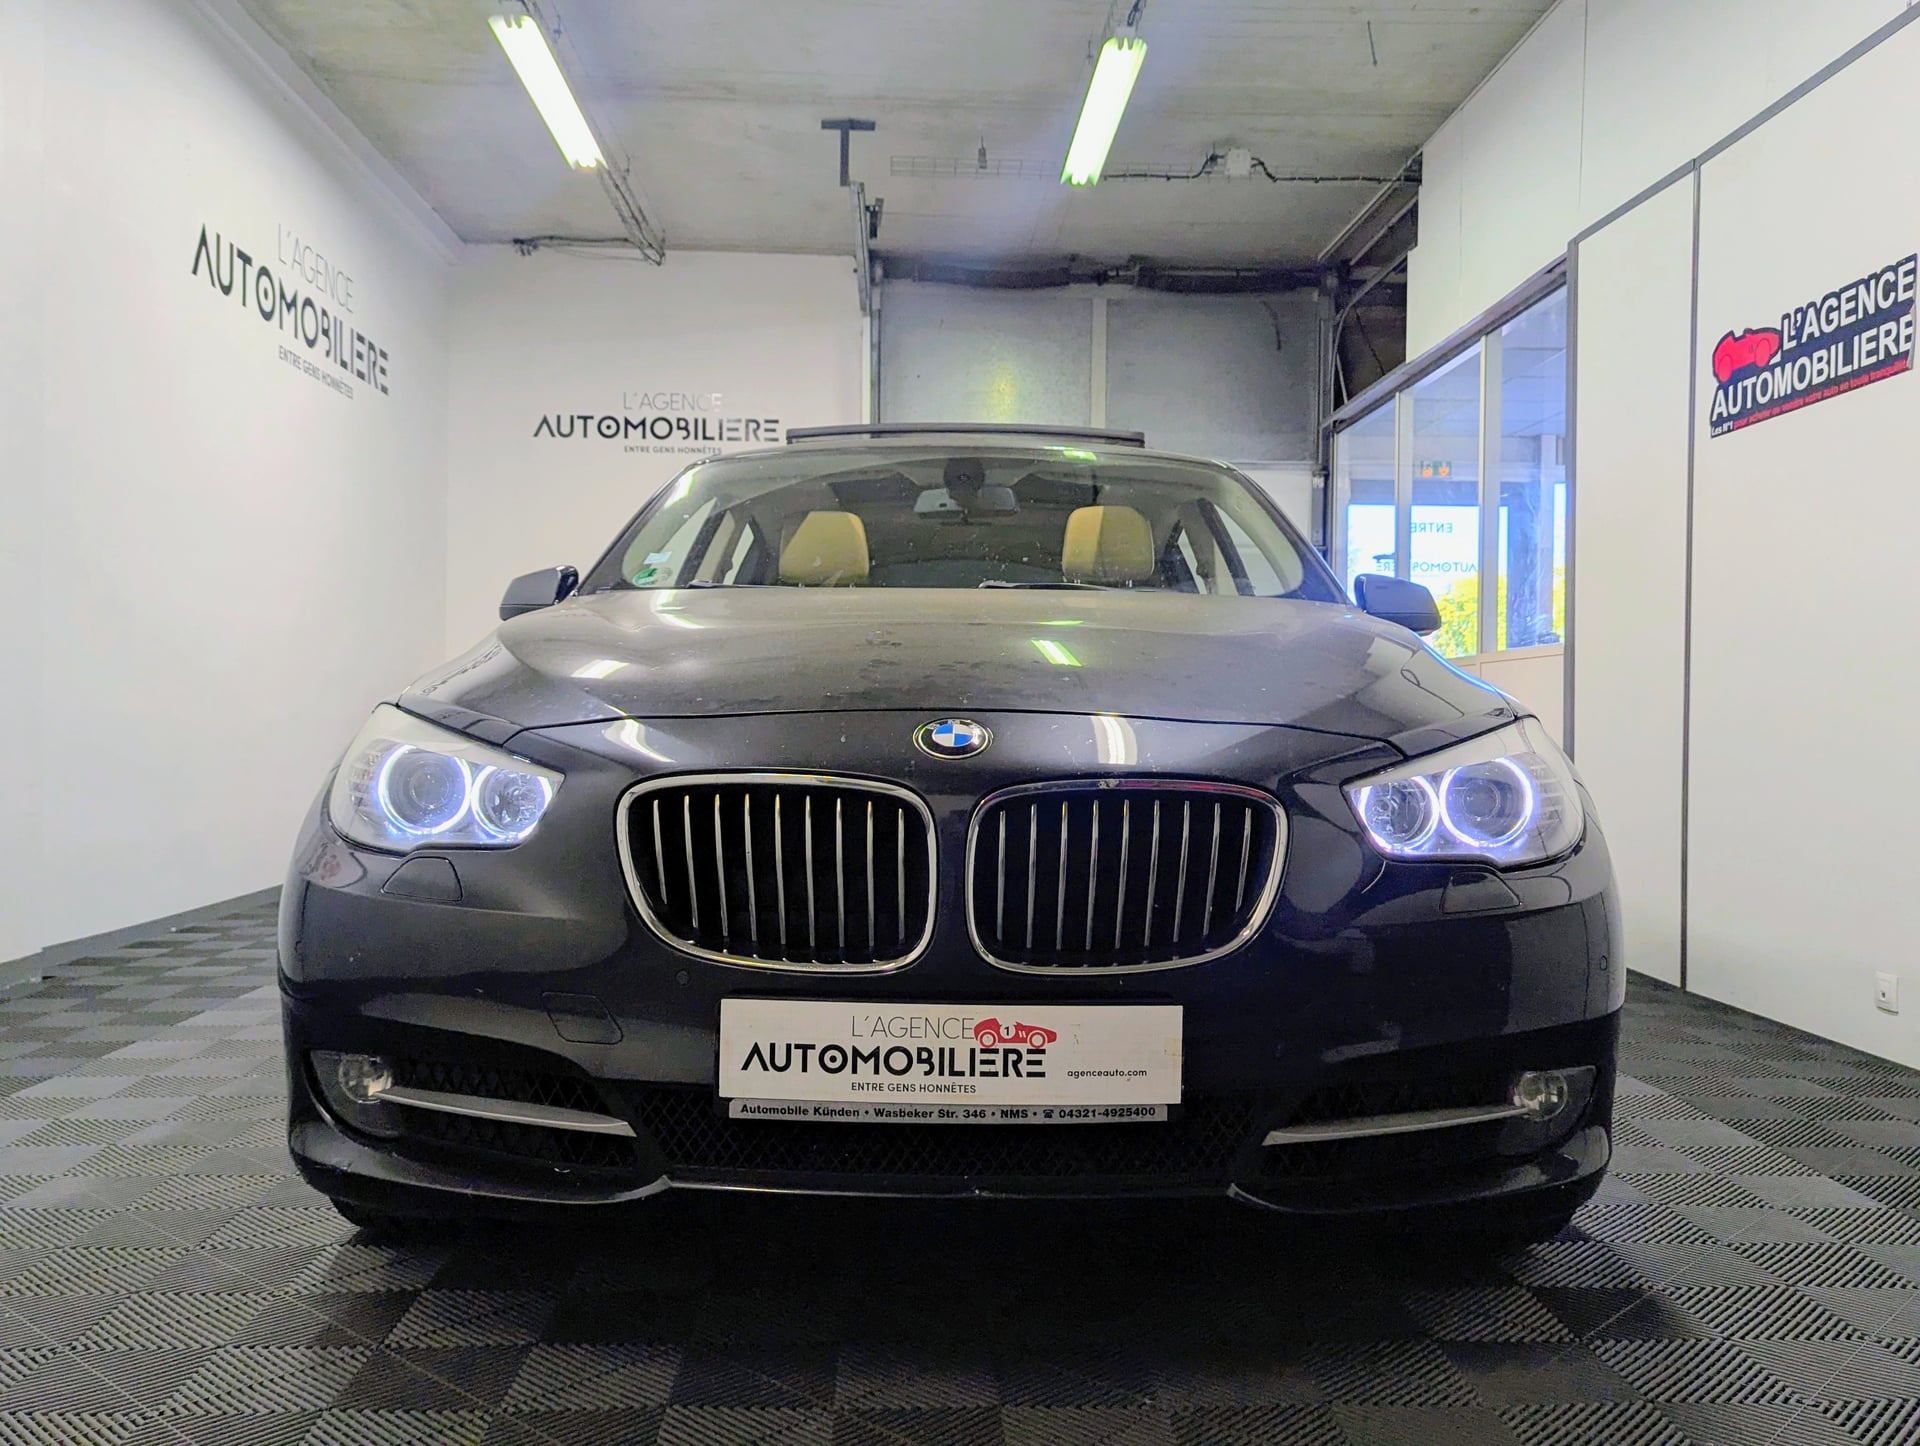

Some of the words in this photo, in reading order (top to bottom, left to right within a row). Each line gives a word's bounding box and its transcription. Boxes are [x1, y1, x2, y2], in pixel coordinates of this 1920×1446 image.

[278, 223, 354, 314] L'AGENCE
[191, 222, 389, 396] AUTOMOBILIERE
[1782, 260, 1915, 351] L'AGENCE
[1711, 315, 1913, 421] AUTOMOBILIERE
[623, 392, 723, 412] L'AGENCE
[533, 414, 780, 443] AUTOMOBILIERE
[624, 445, 651, 454] ENTRE
[652, 446, 675, 454] GENS
[851, 1015, 975, 1040] L'AGENCE
[741, 1041, 1046, 1078] AUTOMOBILIERE
[1067, 1069, 1147, 1079] agenceauto.com
[851, 1082, 884, 1092] ENTRE
[887, 1083, 916, 1093] GENS
[919, 1082, 977, 1094] HONNÊTES
[874, 1108, 934, 1119] Wasbeker
[938, 1109, 958, 1119] Str.
[963, 1110, 986, 1118] 346
[1000, 1109, 1028, 1119] NMS
[1059, 1107, 1156, 1119] 04321-4925400
